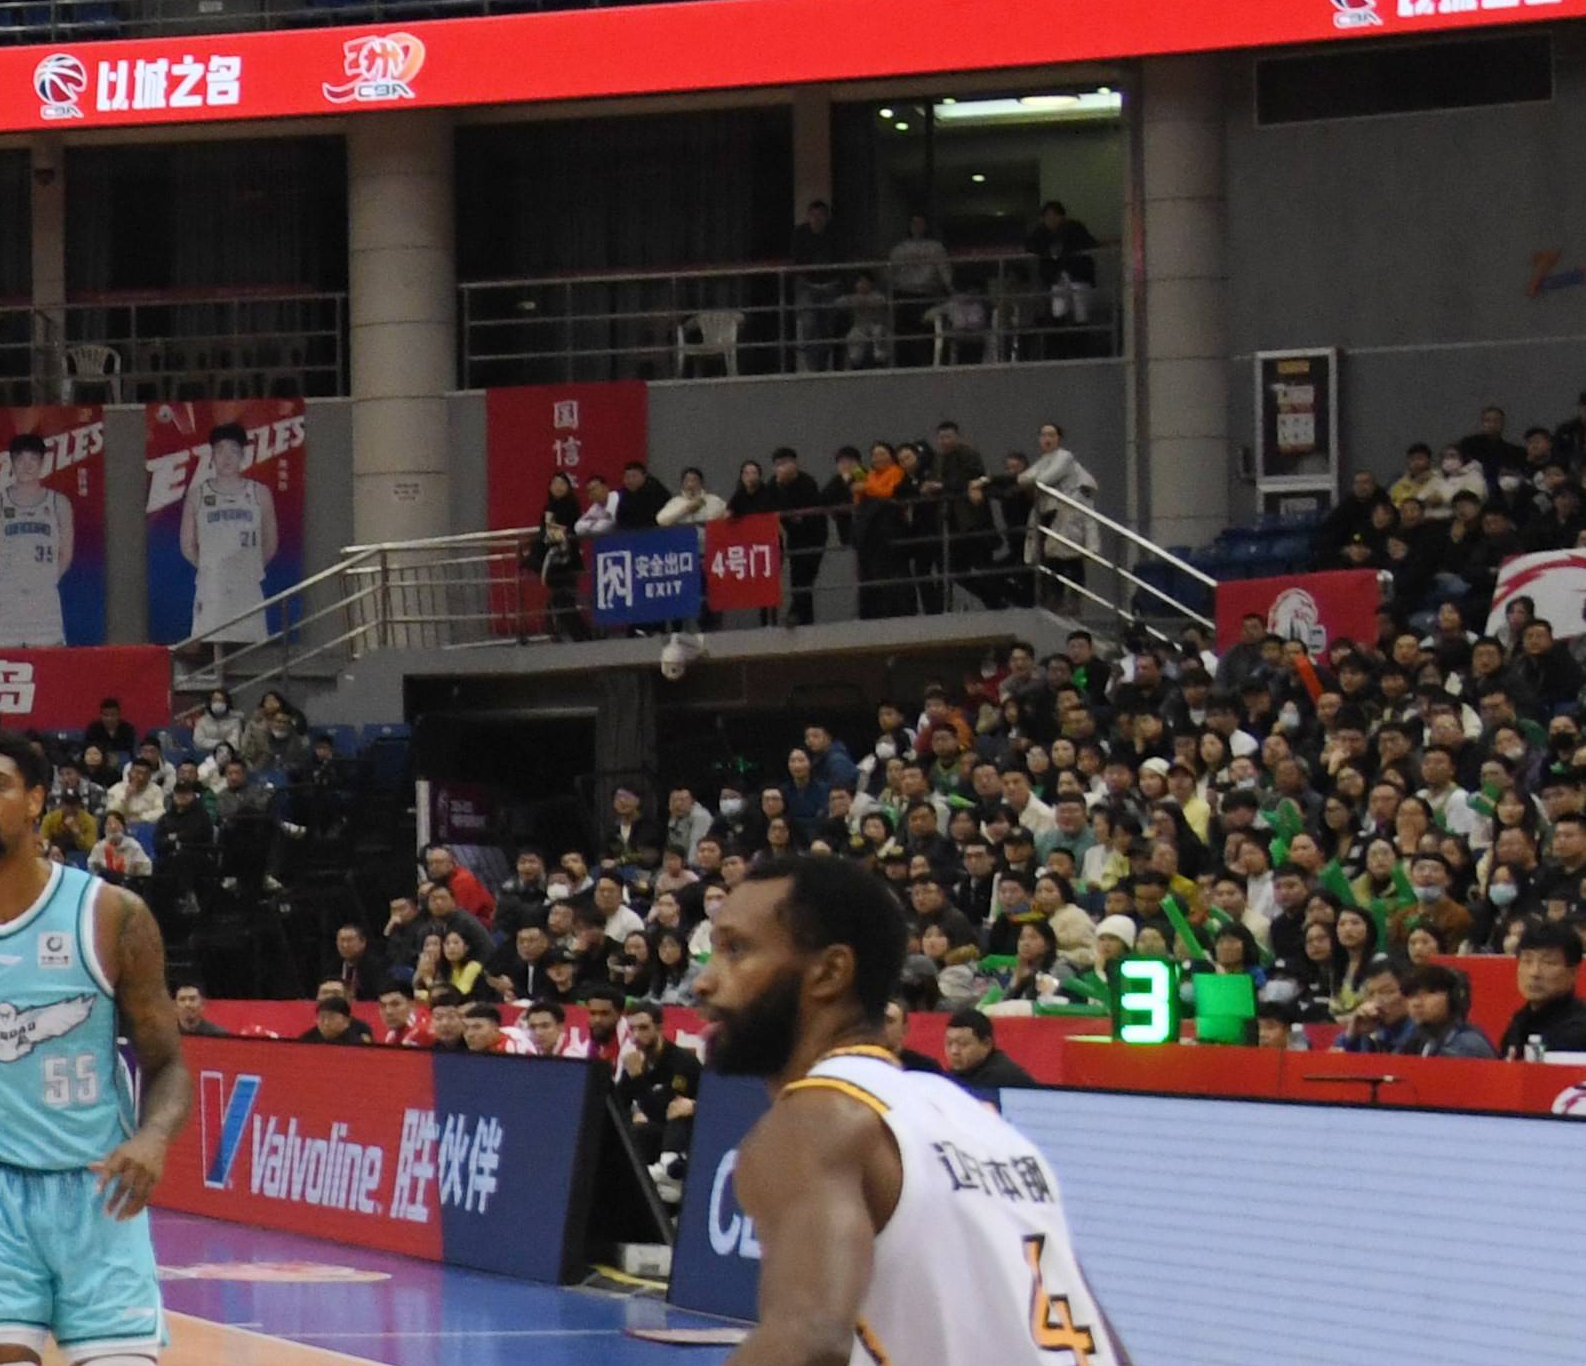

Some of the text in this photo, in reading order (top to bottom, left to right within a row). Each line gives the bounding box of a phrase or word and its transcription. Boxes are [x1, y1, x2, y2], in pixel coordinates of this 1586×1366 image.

[96, 55, 242, 113] 以城之名
[552, 399, 581, 490] 国信
[634, 551, 693, 580] 安全出口
[645, 580, 683, 599] EXIT
[710, 544, 773, 580] 4号门
[1120, 959, 1172, 1044] 3
[43, 1055, 99, 1107] 55
[251, 1108, 506, 1224] Valvoline 胜伙伴
